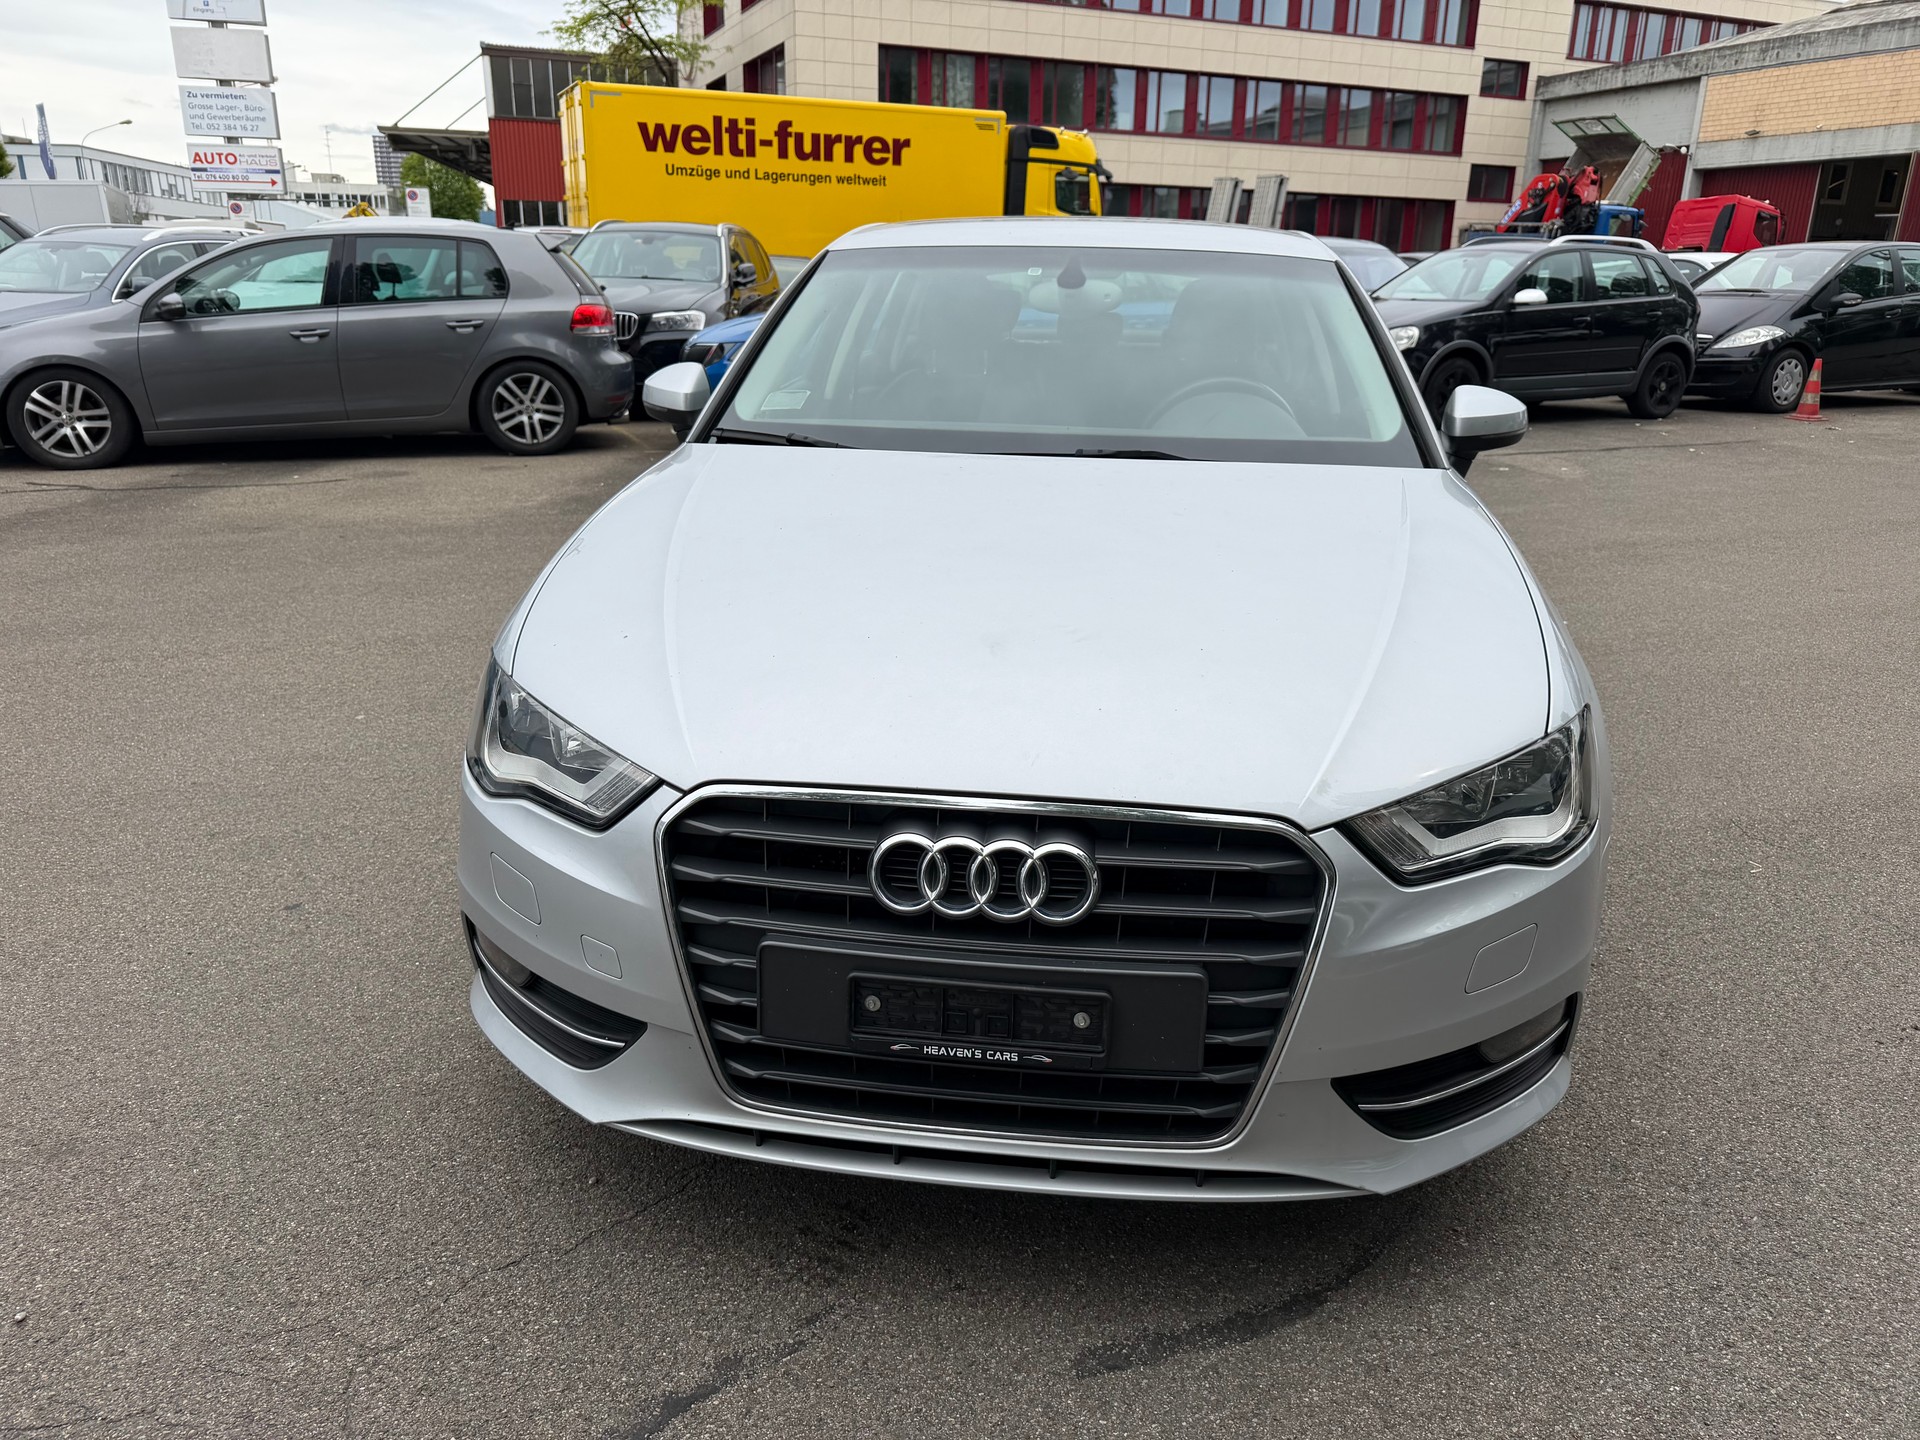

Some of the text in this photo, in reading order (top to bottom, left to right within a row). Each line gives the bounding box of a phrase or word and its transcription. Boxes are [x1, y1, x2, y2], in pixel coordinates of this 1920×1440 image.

[199, 91, 247, 100] vermieten:
[187, 102, 214, 110] Grosse
[244, 103, 265, 112] Büro-
[189, 112, 267, 122] und Gewerberäume
[191, 122, 205, 130] Tel.
[206, 123, 220, 131] 052
[223, 123, 237, 131] 384
[249, 124, 259, 132] 27
[637, 115, 911, 166] welti-furrer
[192, 151, 278, 167] AUTO HAUS
[665, 163, 887, 187] Umzüge und Lagerungen weltweit
[924, 1045, 1019, 1062] HEAVEN'S CARS
